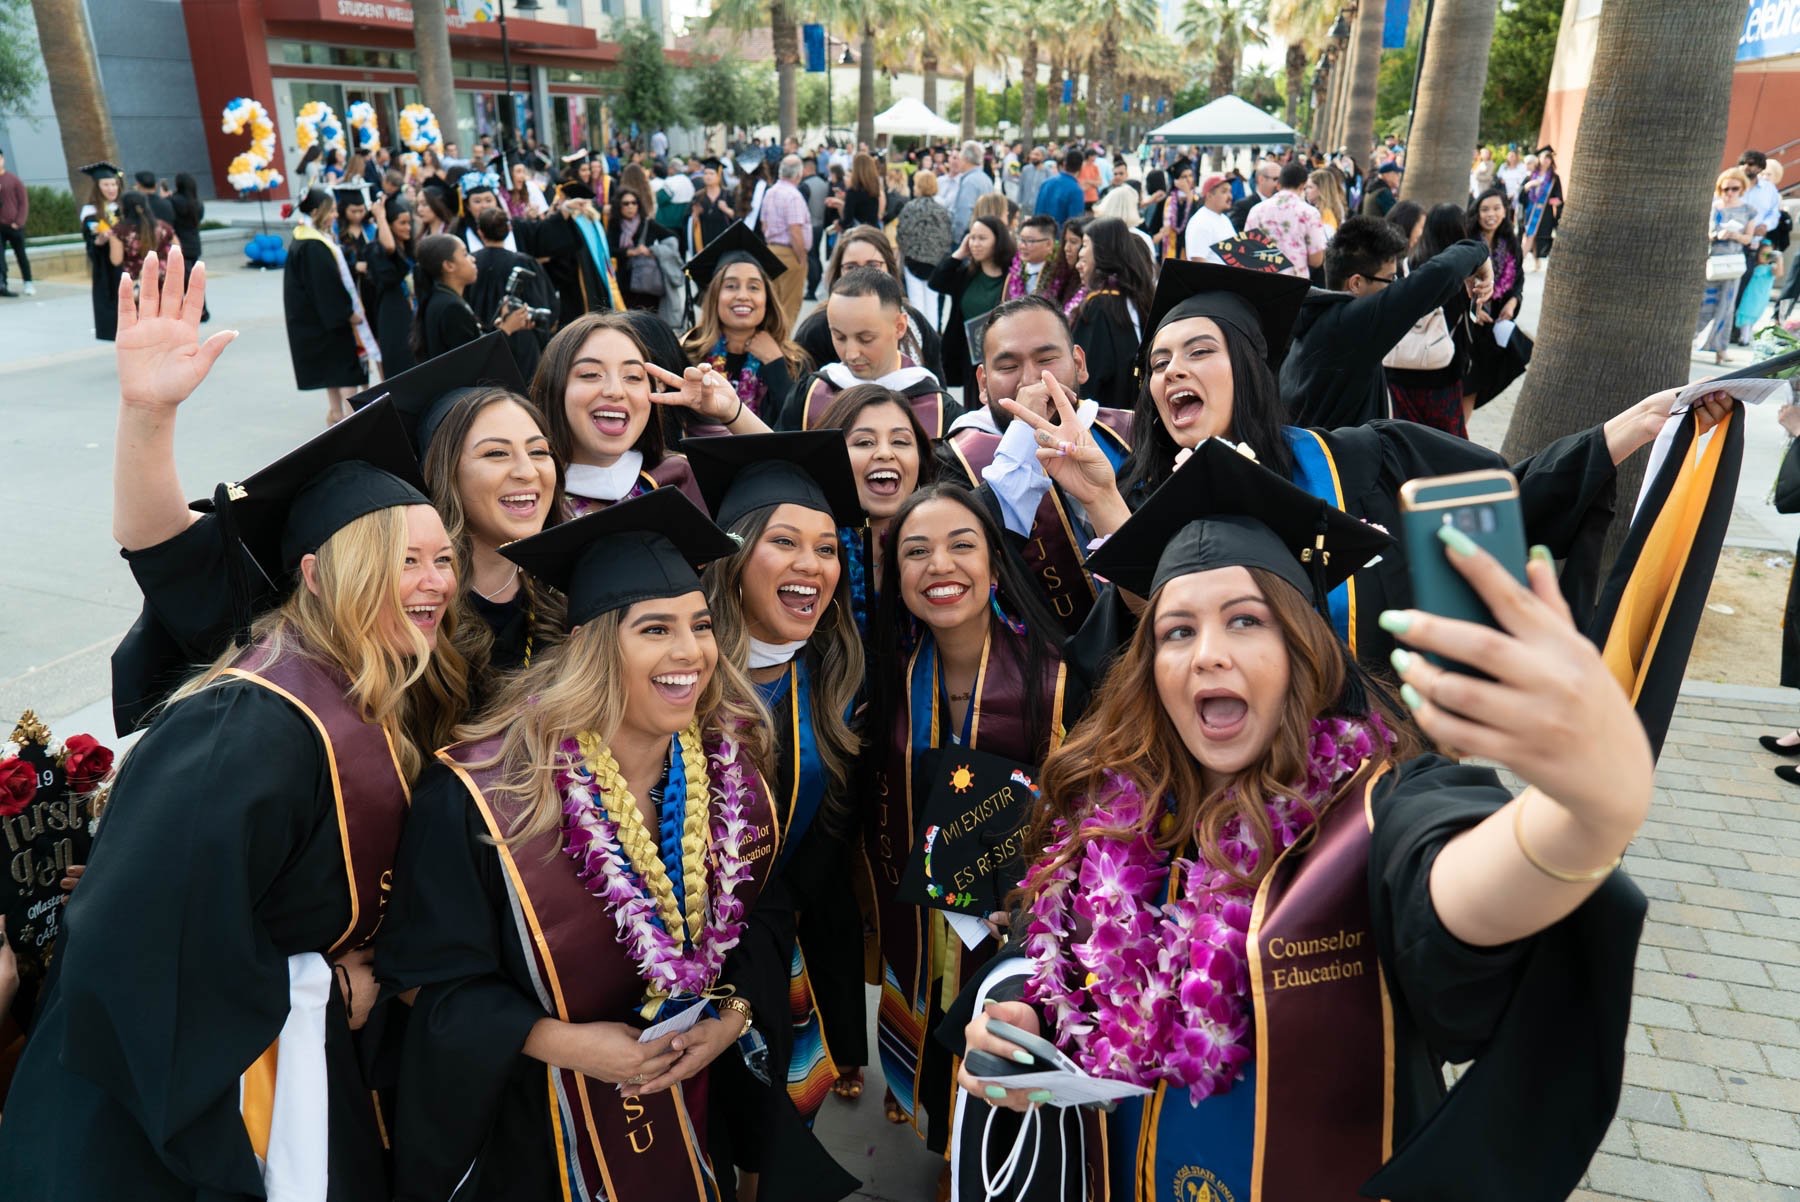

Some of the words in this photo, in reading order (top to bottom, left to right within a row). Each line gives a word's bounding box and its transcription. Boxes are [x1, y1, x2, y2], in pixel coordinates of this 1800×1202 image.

[338, 0, 385, 20] STUDENT
[386, 6, 414, 23] WELL
[1218, 241, 1232, 251] TO
[1238, 245, 1246, 254] A
[1259, 252, 1284, 264] NEW
[941, 820, 962, 846] MI
[960, 785, 1015, 832] EXISTIR
[739, 843, 771, 863] ucation
[11, 838, 74, 897] gen
[953, 866, 976, 891] ES
[46, 907, 57, 928] of
[1268, 930, 1366, 960] Counselor
[1272, 959, 1365, 990] Education
